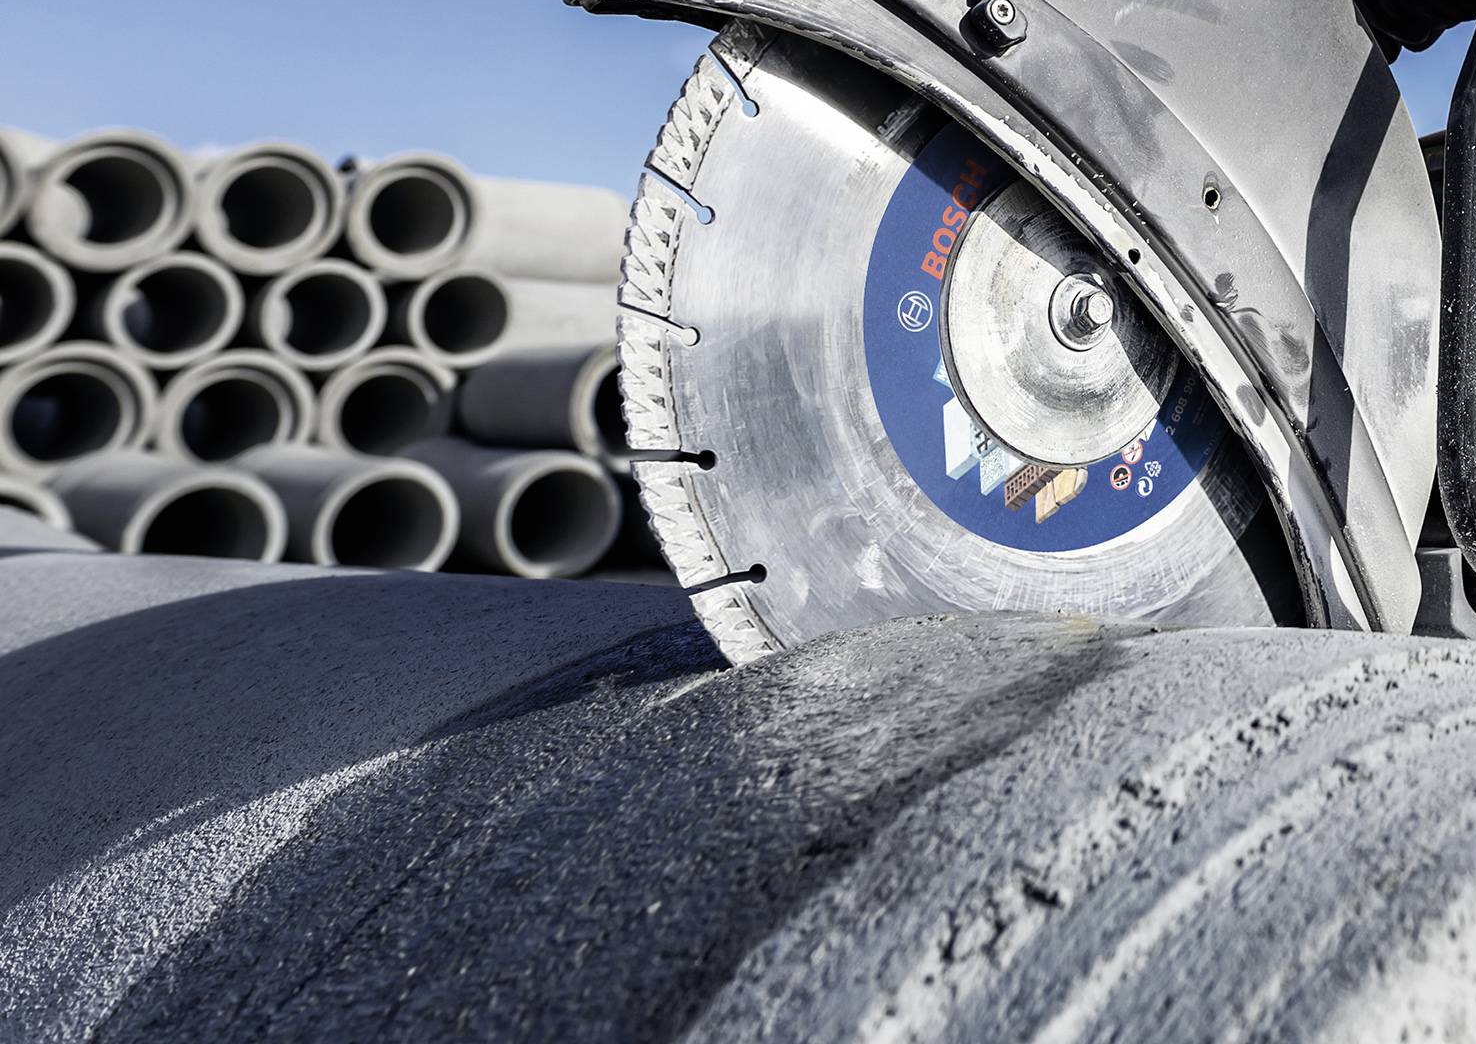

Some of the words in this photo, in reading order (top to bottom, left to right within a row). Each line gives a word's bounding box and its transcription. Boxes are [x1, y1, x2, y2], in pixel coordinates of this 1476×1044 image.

[920, 157, 991, 281] BOSCH
[1165, 425, 1176, 436] 2
[1171, 396, 1188, 423] 608
